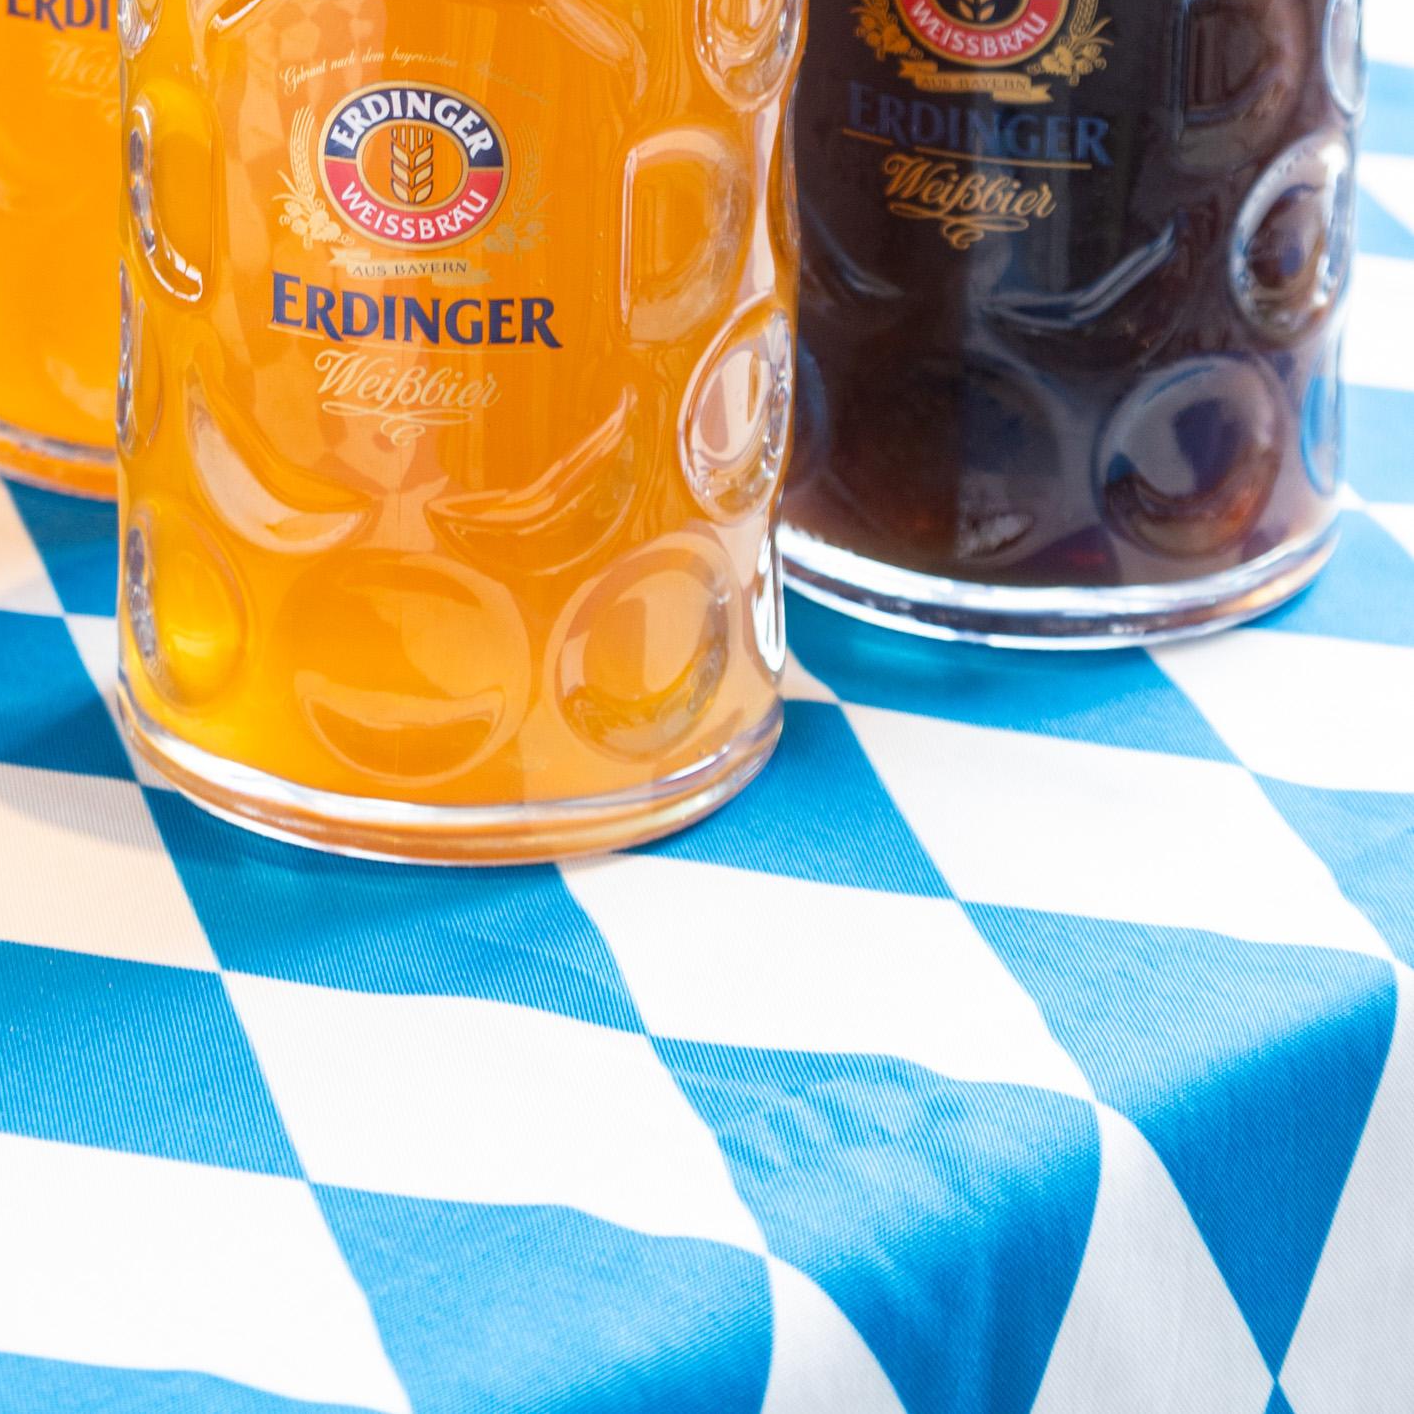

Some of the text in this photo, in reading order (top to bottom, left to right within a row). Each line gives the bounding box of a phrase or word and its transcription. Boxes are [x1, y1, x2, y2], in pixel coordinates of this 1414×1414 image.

[361, 47, 386, 65] dem
[330, 90, 494, 160] ERDINGER
[847, 79, 1116, 169] ERDINGER
[352, 260, 468, 278] AUS BAYERN
[270, 270, 564, 350] ERDINGER
[313, 347, 503, 412] Weißbier
